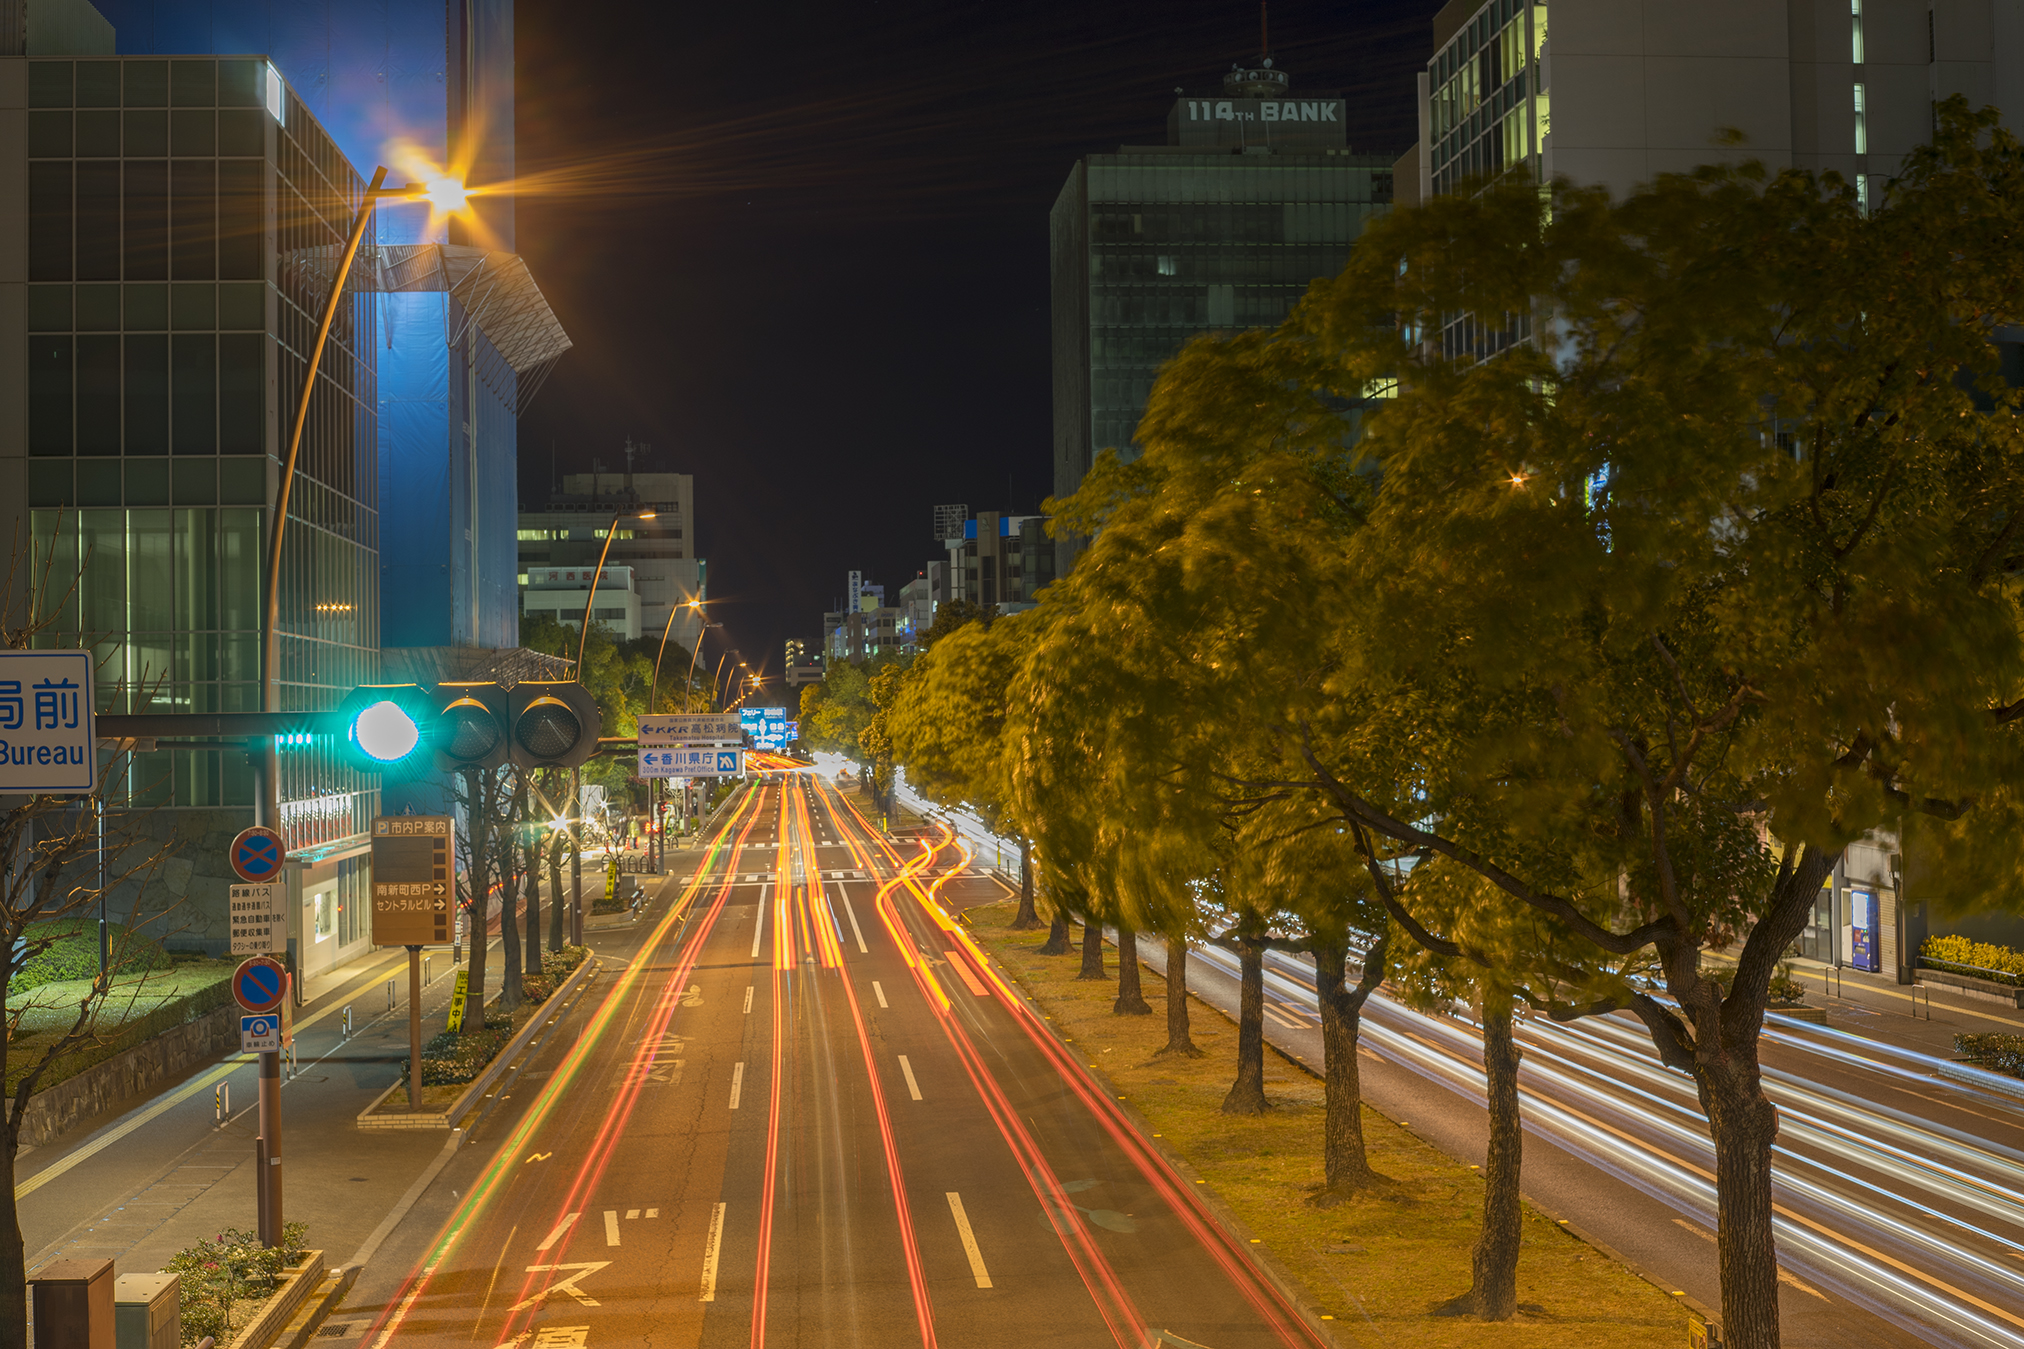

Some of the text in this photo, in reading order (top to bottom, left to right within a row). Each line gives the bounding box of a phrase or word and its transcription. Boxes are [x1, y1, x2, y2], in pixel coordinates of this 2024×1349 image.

[1260, 101, 1338, 122] BANK
[660, 752, 714, 765] 香川県庁
[661, 766, 683, 774] Kagawa
[391, 821, 446, 834] 市内P案内
[231, 887, 270, 898] 路線バス
[376, 884, 431, 896] 南新町西P
[376, 900, 432, 911] セントラルビル
[232, 914, 270, 925] 緊急自動車
[232, 928, 270, 939] 郵便収集車
[452, 986, 466, 1018] 工事中
